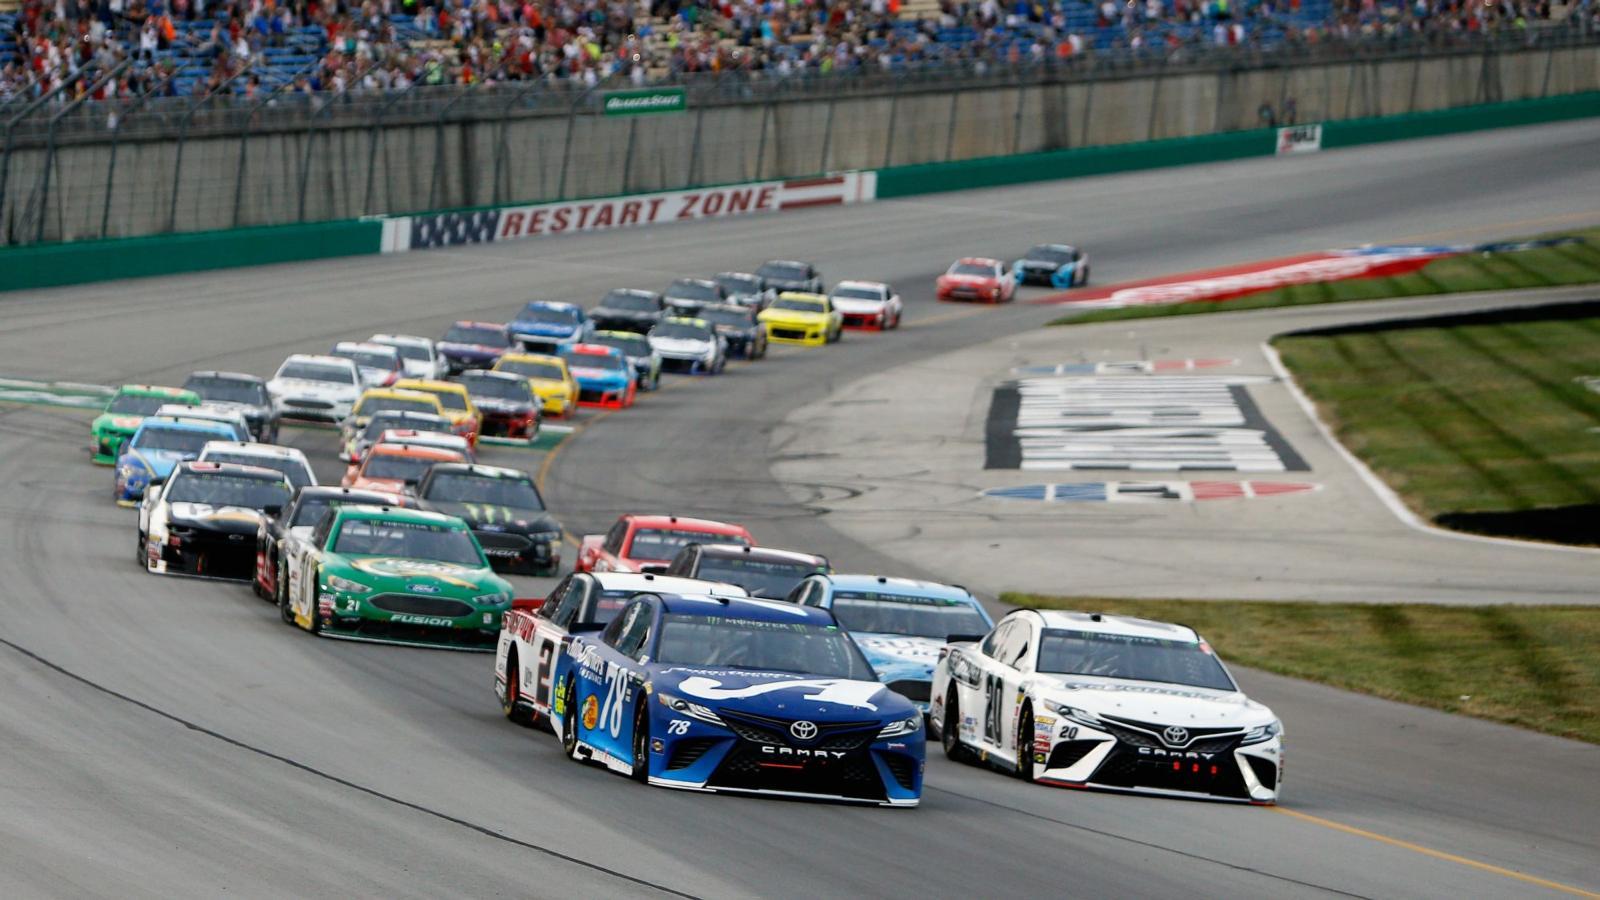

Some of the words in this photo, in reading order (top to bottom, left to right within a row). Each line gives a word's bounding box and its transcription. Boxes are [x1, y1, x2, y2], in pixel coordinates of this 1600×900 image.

[502, 199, 665, 237] RESTART
[677, 186, 777, 219] ZONE
[725, 617, 789, 630] MONSTER
[536, 638, 556, 707] 2
[599, 660, 628, 739] 78
[983, 671, 1004, 749] 20
[667, 719, 691, 735] 78
[1059, 725, 1079, 740] 20
[761, 745, 847, 759] CAMRY
[1138, 746, 1215, 760] CAMRY
